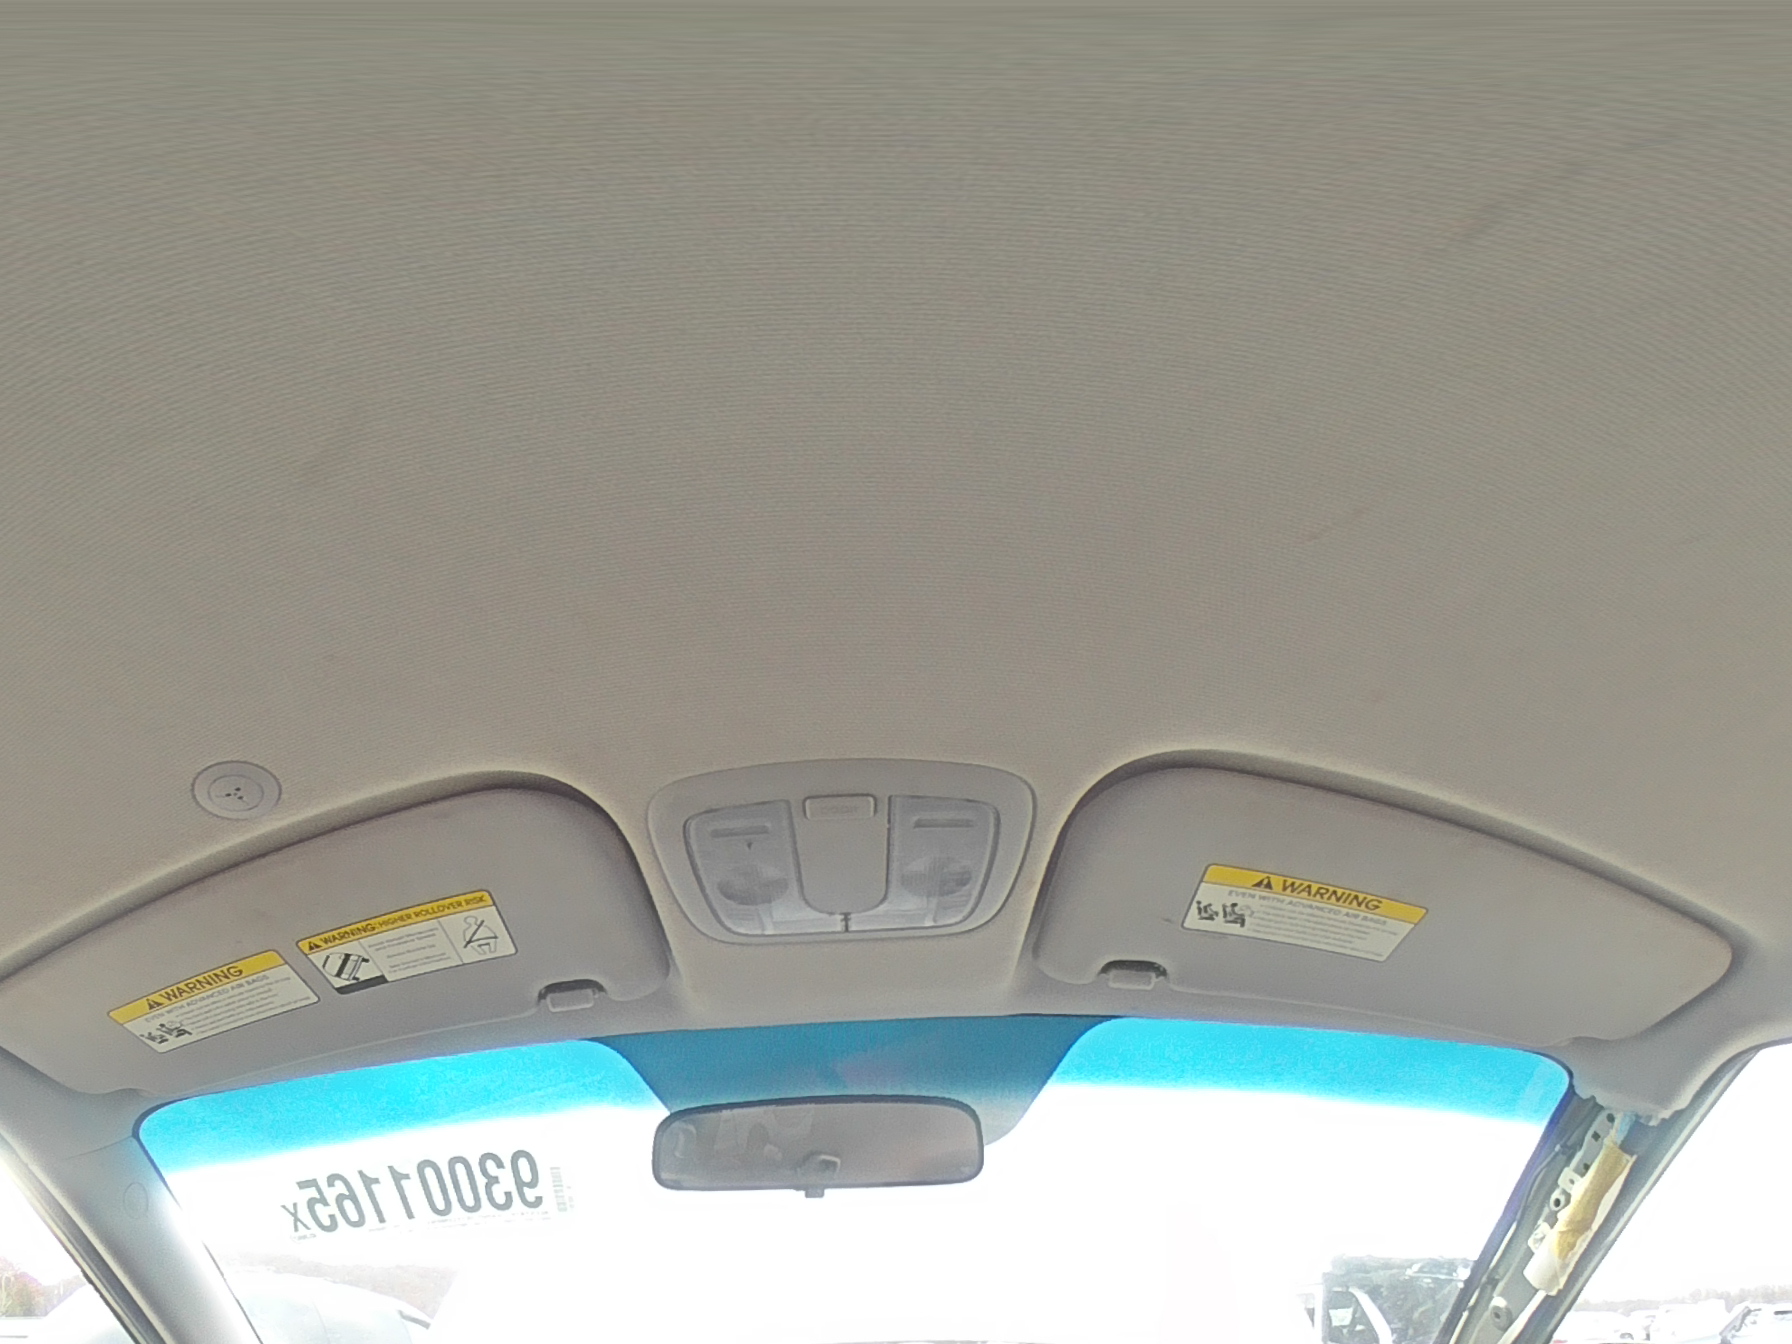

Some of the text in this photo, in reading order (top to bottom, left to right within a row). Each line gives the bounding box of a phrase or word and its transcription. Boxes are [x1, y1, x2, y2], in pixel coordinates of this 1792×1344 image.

[379, 912, 412, 929] HIGHER
[413, 899, 463, 919] ROLLOVER
[464, 894, 487, 908] RISK
[1281, 878, 1383, 911] WARNING
[159, 965, 243, 1002] WARNING
